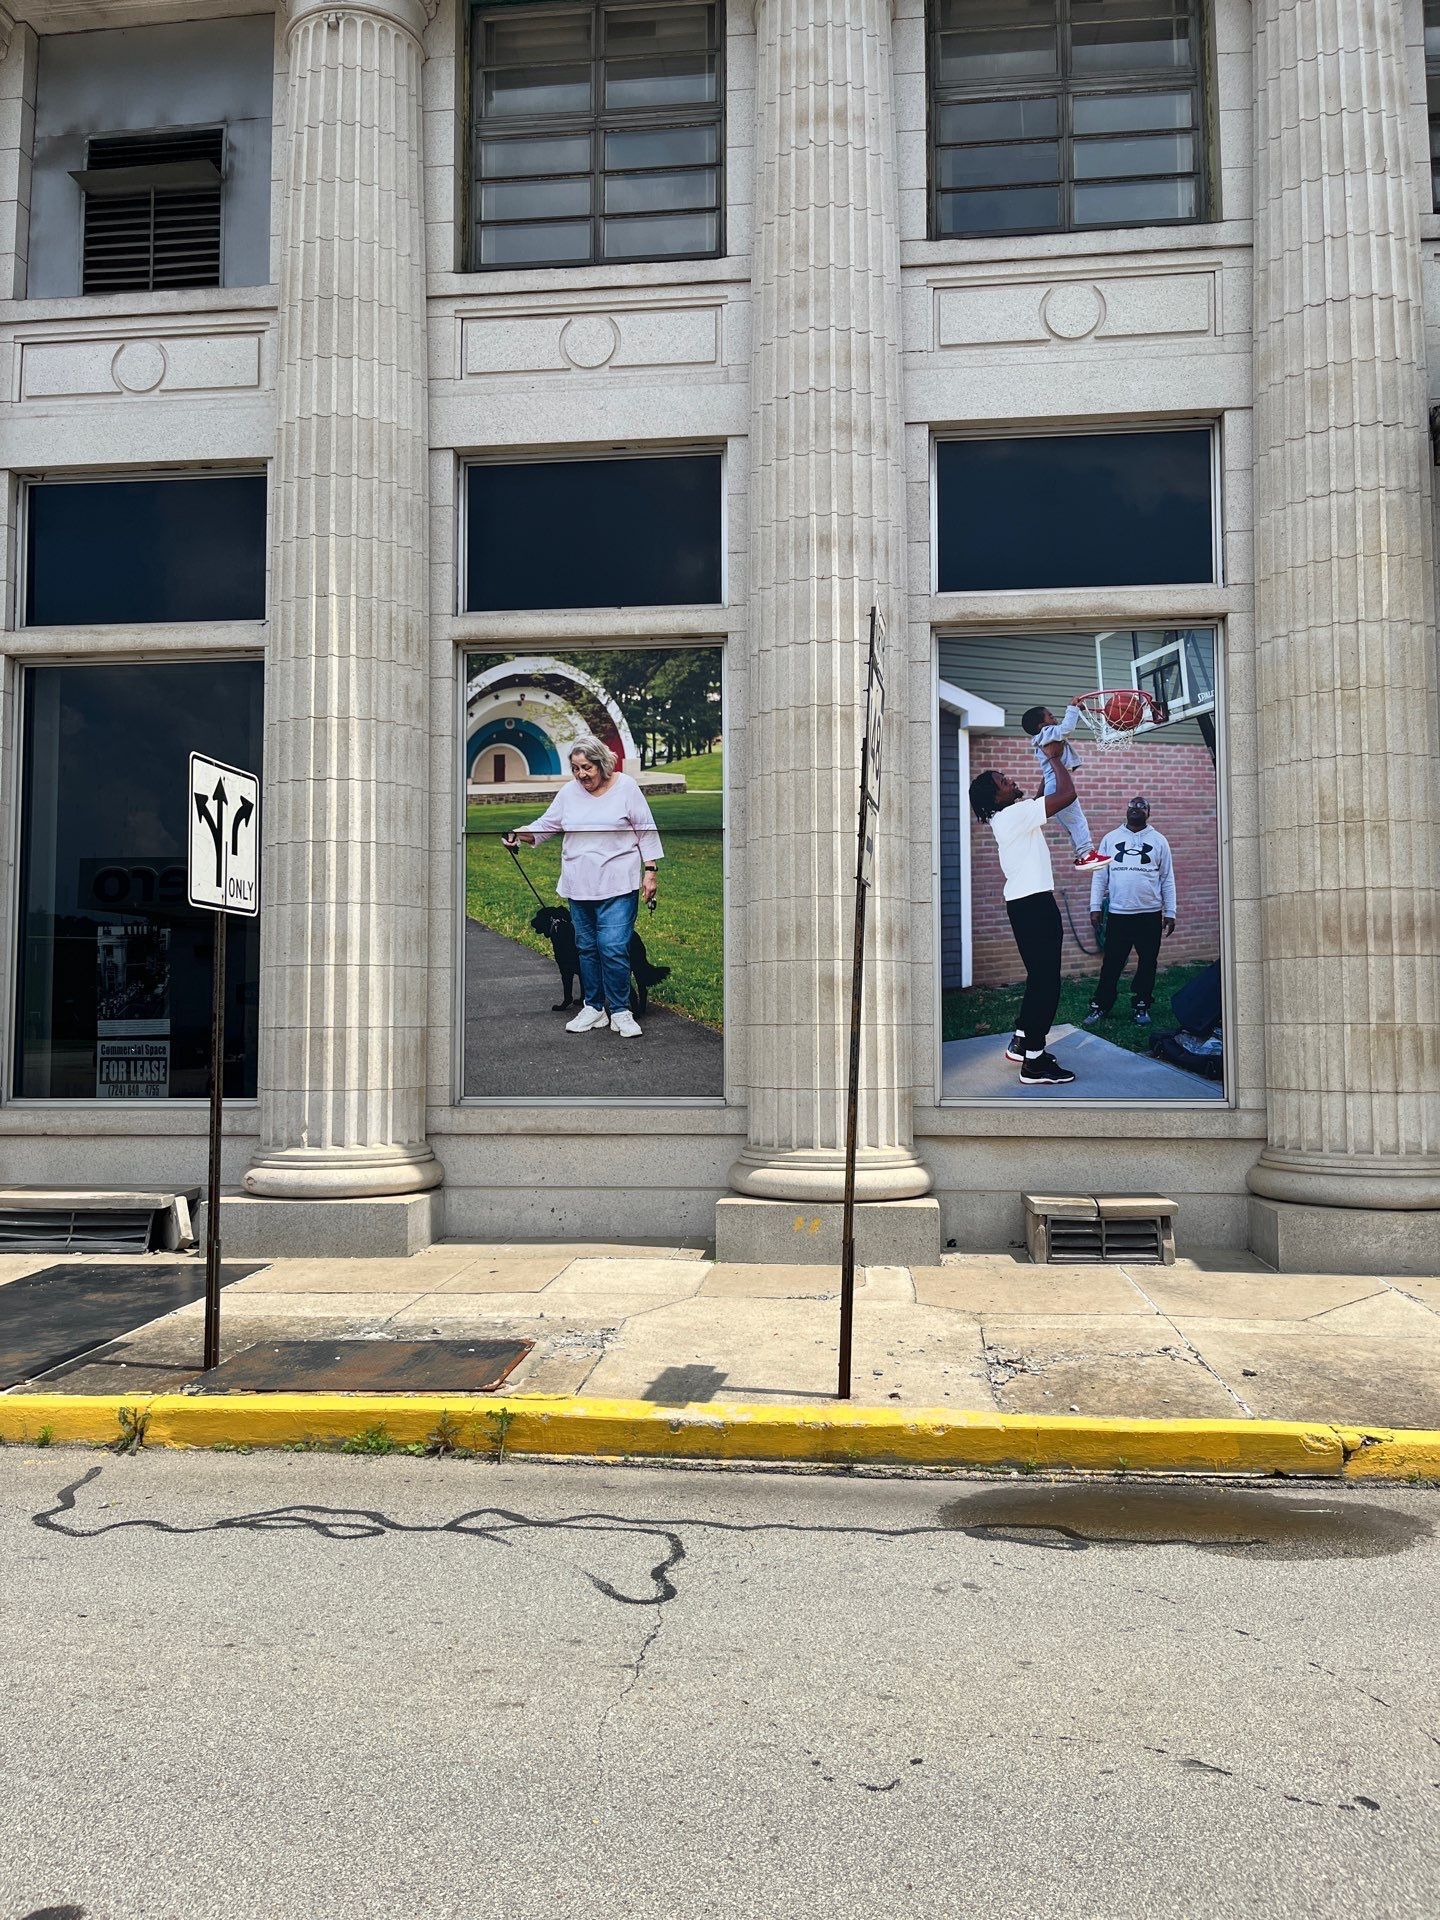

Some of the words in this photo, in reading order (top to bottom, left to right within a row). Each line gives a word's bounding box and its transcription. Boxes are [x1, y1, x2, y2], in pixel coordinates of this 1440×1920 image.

[229, 877, 254, 901] ONLY
[101, 1044, 143, 1055] Commercial
[145, 1044, 166, 1056] Space
[102, 1060, 127, 1081] FOR
[130, 1060, 166, 1081] LEASE
